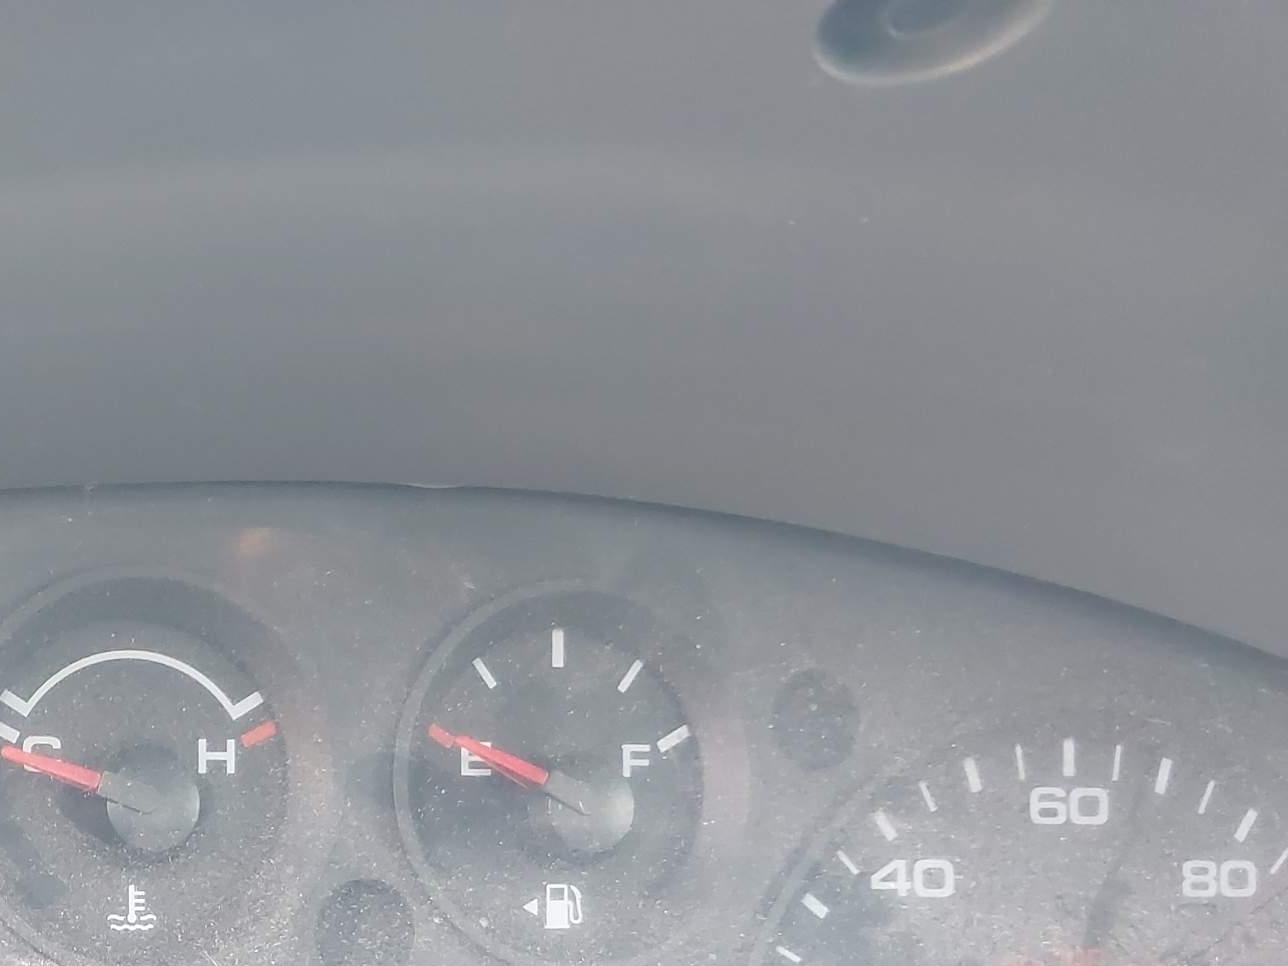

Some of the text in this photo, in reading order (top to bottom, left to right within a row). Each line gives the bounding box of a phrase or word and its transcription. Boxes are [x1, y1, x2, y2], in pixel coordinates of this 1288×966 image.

[197, 738, 236, 775] H
[460, 741, 493, 777] E
[621, 743, 652, 778] F
[1029, 786, 1109, 826] 60
[869, 858, 956, 899] 40
[1181, 859, 1258, 898] 80
